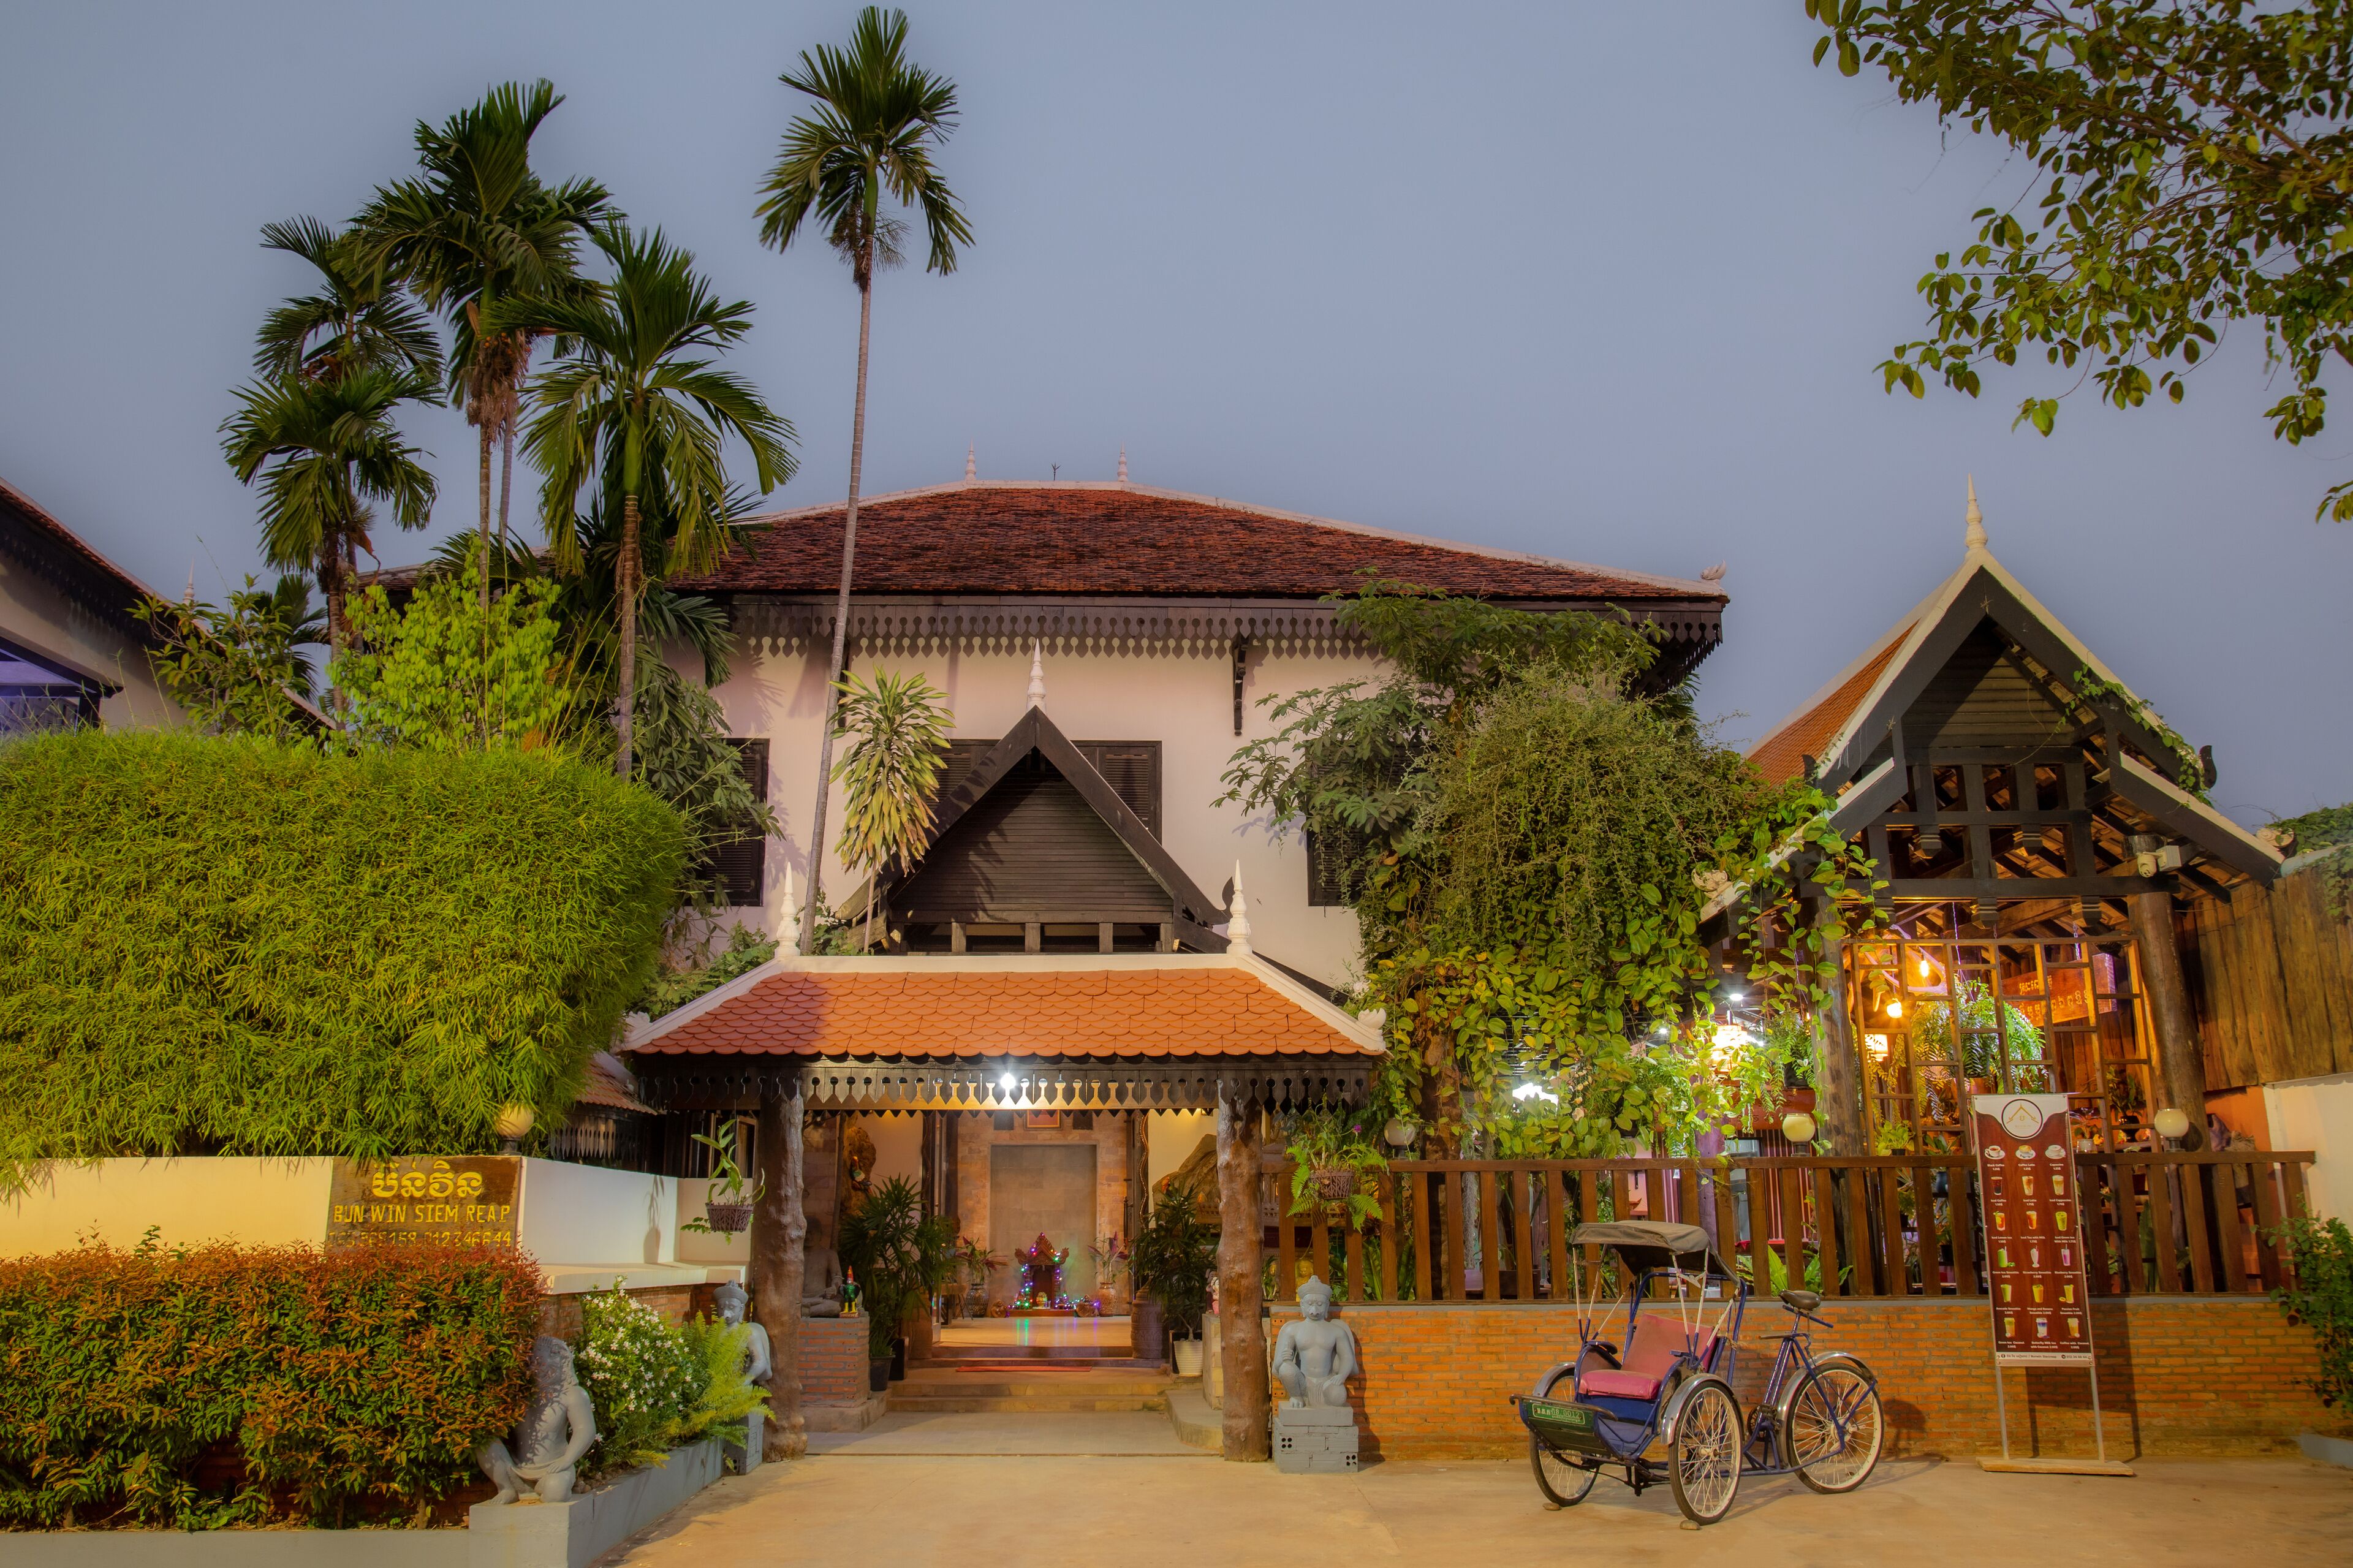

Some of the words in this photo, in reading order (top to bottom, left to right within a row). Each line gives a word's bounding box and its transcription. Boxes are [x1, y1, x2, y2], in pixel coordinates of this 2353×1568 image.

[334, 1205, 364, 1222] BUN
[371, 1205, 406, 1223] WIN
[415, 1205, 458, 1222] SIEM
[466, 1205, 510, 1223] REAP
